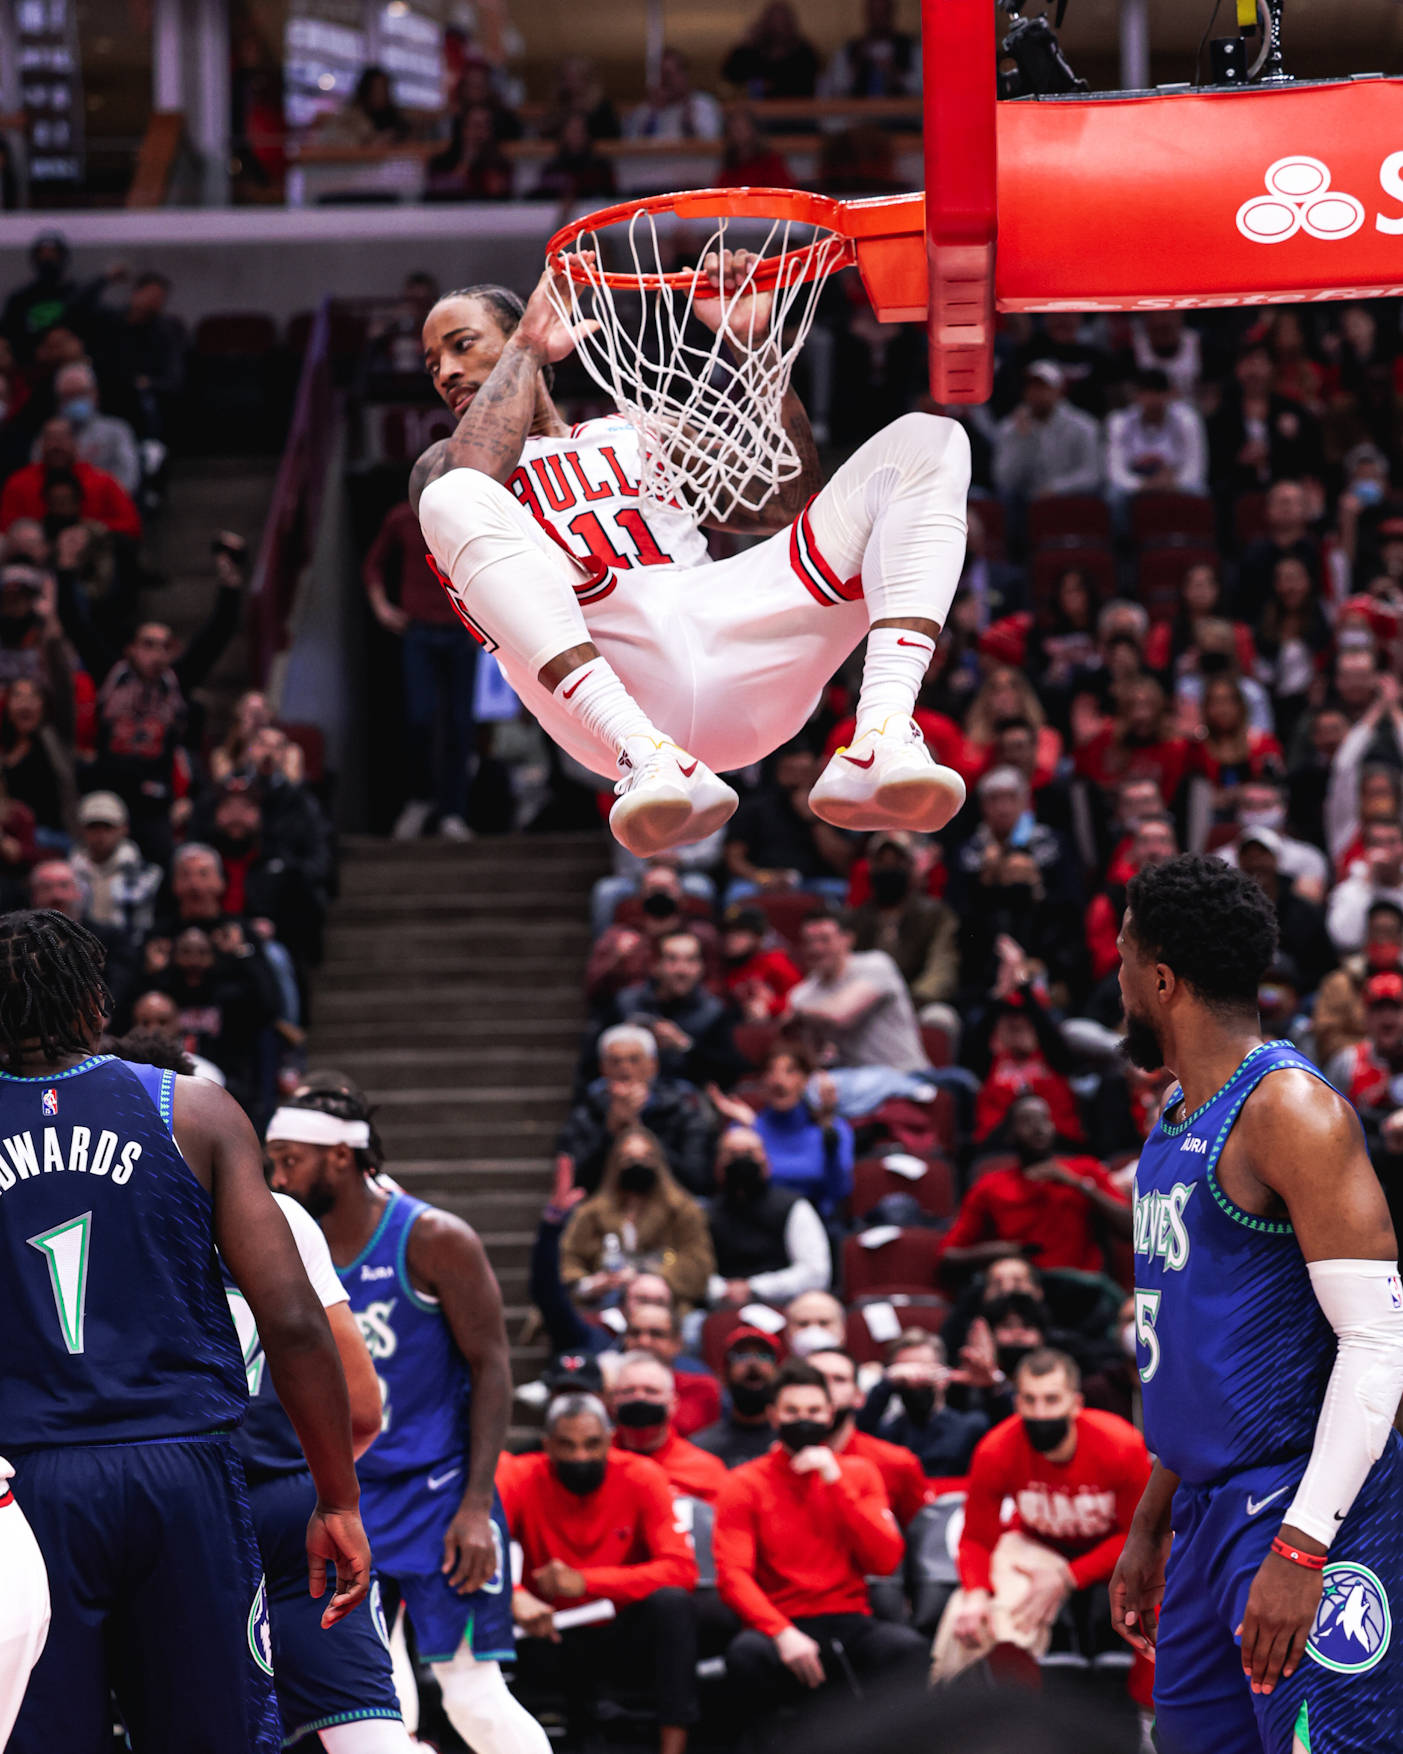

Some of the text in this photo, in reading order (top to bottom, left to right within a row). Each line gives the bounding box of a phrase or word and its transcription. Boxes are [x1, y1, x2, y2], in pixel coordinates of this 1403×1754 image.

[1131, 294, 1307, 309] State
[567, 508, 675, 570] 11
[0, 1126, 142, 1196] DWARDS
[1132, 1176, 1198, 1272] OLVES
[25, 1210, 93, 1354] 1
[1134, 1287, 1162, 1384] 5
